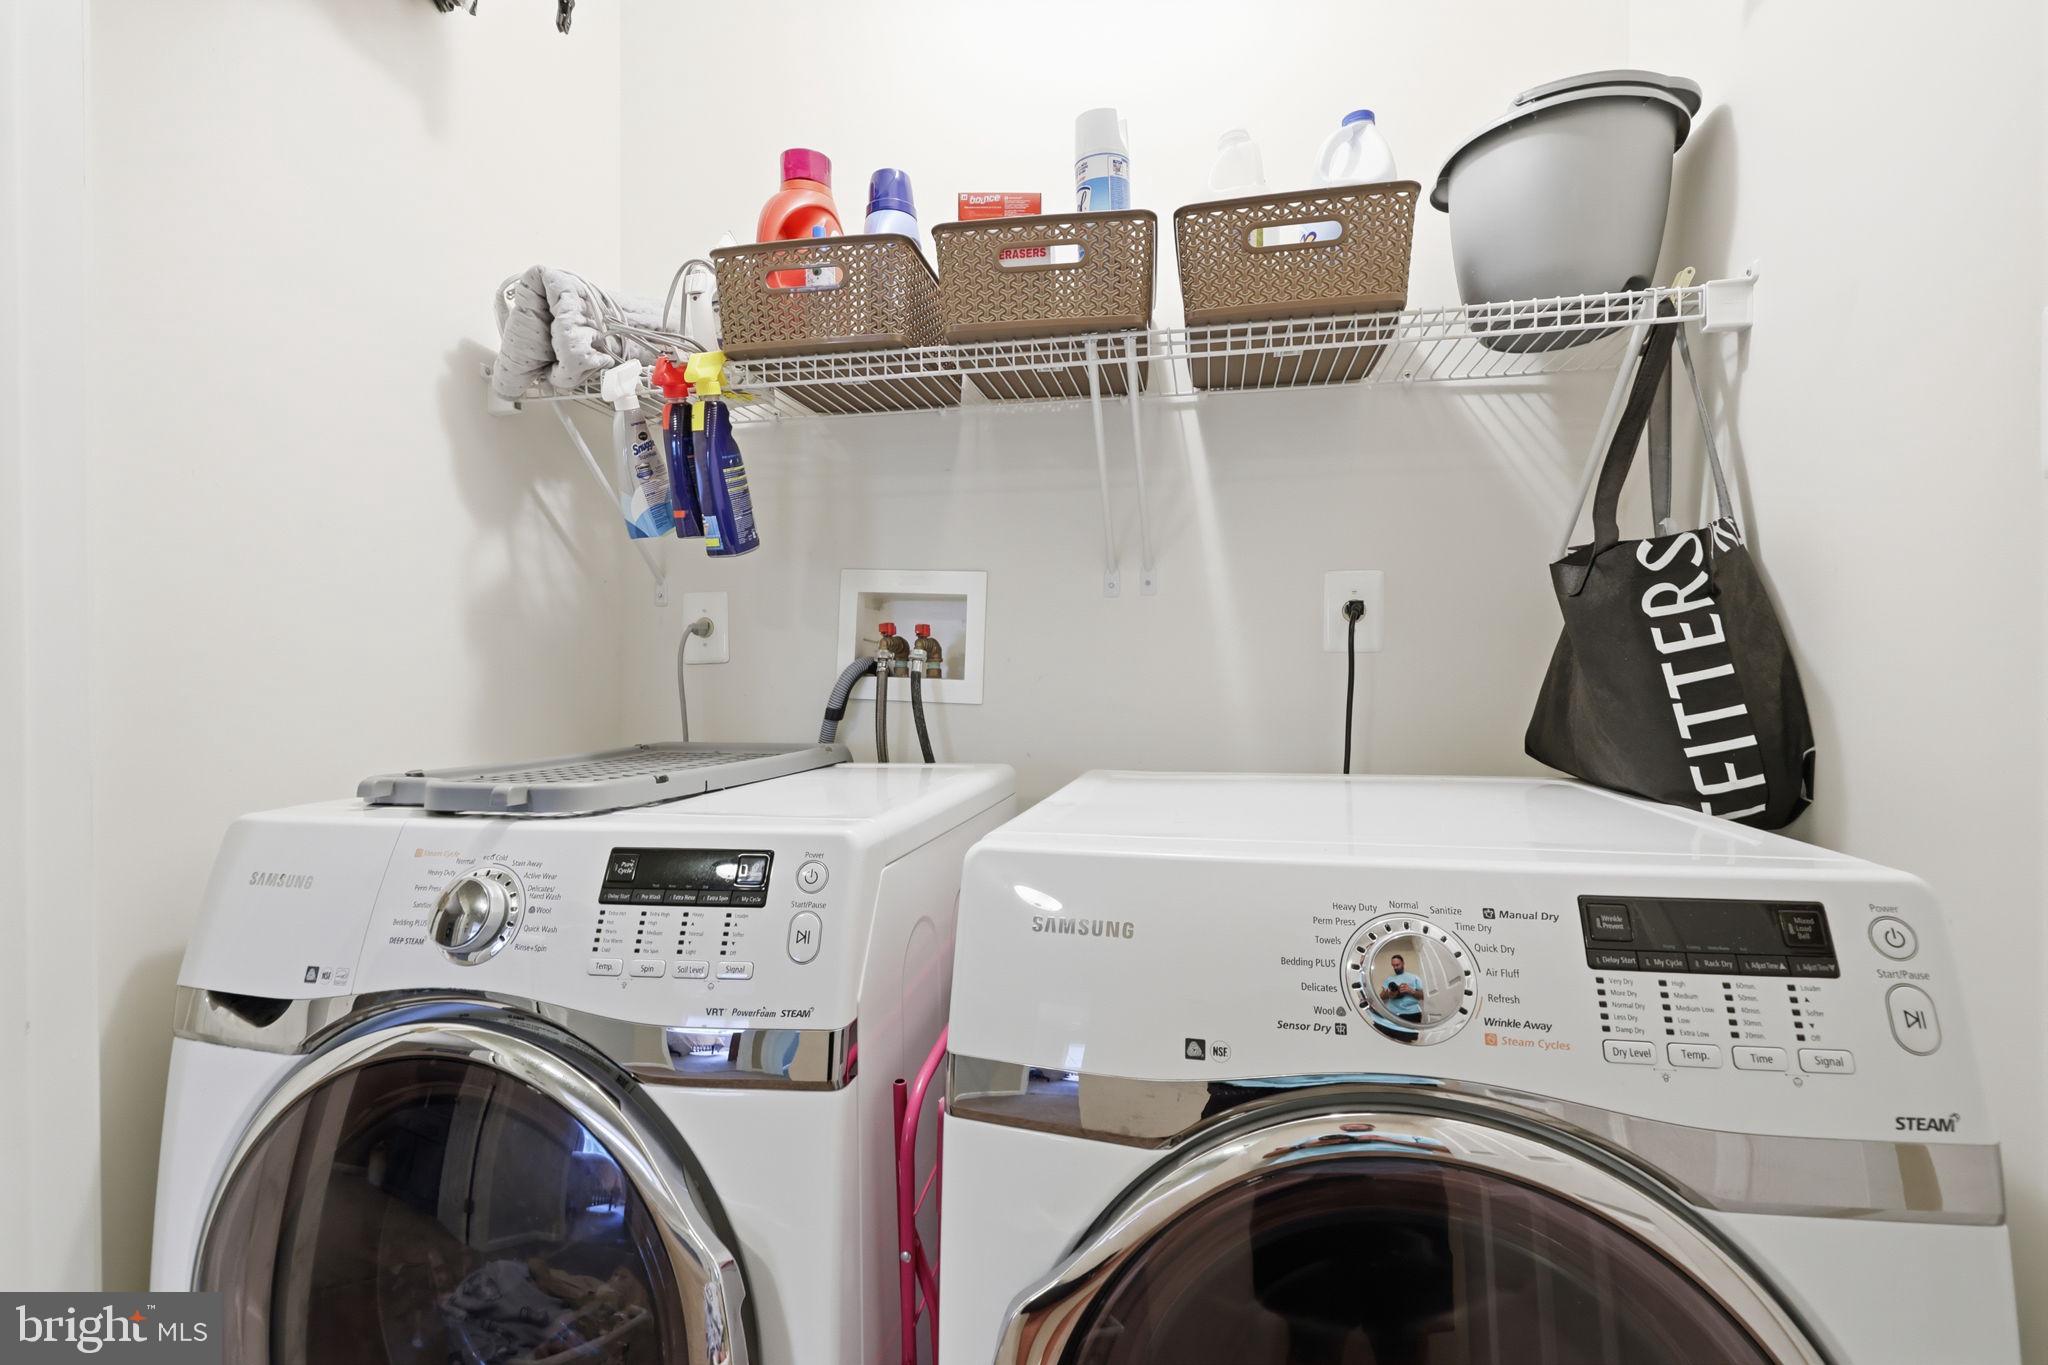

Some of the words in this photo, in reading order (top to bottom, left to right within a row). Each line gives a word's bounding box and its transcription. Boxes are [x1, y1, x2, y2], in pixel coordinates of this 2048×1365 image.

[969, 194, 1001, 205] bounce
[999, 247, 1046, 260] ERASERS
[804, 851, 824, 859] Power
[248, 871, 314, 890] SAMSUNG
[791, 901, 827, 909] Start/Pause
[1332, 902, 1356, 913] Heavy
[1358, 903, 1378, 914] Duty
[1389, 900, 1419, 909] Normal
[1869, 903, 1898, 913] Power
[1429, 906, 1462, 916] Sanitize
[1499, 910, 1538, 920] Manual
[1541, 912, 1560, 922] Dry
[1312, 916, 1333, 925] Perm
[1335, 917, 1356, 926] Press
[1032, 916, 1134, 939] SAMSUNG
[1455, 922, 1475, 932] Time
[1478, 924, 1492, 934] Dry
[404, 937, 424, 945] STEAM
[1315, 936, 1341, 945] Towels
[514, 944, 547, 952] Rinse+Spin
[1474, 944, 1498, 953] Quick
[1500, 945, 1515, 956] Dry
[1281, 956, 1314, 968] Bedding
[1315, 959, 1336, 968] PLUS
[641, 965, 654, 973] Spin
[726, 965, 746, 974] Signal
[1486, 968, 1498, 977] Air
[1500, 969, 1520, 978] Fluff
[1877, 969, 1930, 981] Start/Pause
[1301, 982, 1338, 993] Delicates
[1623, 978, 1633, 986] Dry
[1488, 994, 1520, 1004] Refresh
[1627, 990, 1638, 998] Dry
[706, 1008, 724, 1016] VRT
[732, 1006, 776, 1018] PowerFoam
[781, 1008, 811, 1018] STEAM
[1314, 1006, 1335, 1016] Wool
[1634, 1003, 1645, 1011] Dry
[1484, 1017, 1522, 1029] Wrinkle
[1523, 1020, 1552, 1032] Away
[1627, 1015, 1638, 1023] Dry
[1277, 1020, 1311, 1031] Sensor
[1313, 1022, 1332, 1034] Dry
[1615, 1026, 1633, 1034] Damp
[1634, 1027, 1645, 1035] Dry
[1501, 1036, 1534, 1048] Steam
[1538, 1039, 1571, 1051] Cycles
[1212, 1045, 1228, 1058] NSF
[1612, 1047, 1627, 1059] Dry
[1629, 1048, 1652, 1058] Level
[1681, 1050, 1710, 1062] Temp.
[1750, 1053, 1774, 1064] Time
[1814, 1056, 1844, 1068] Signal
[1896, 1117, 1956, 1132] STEAM
